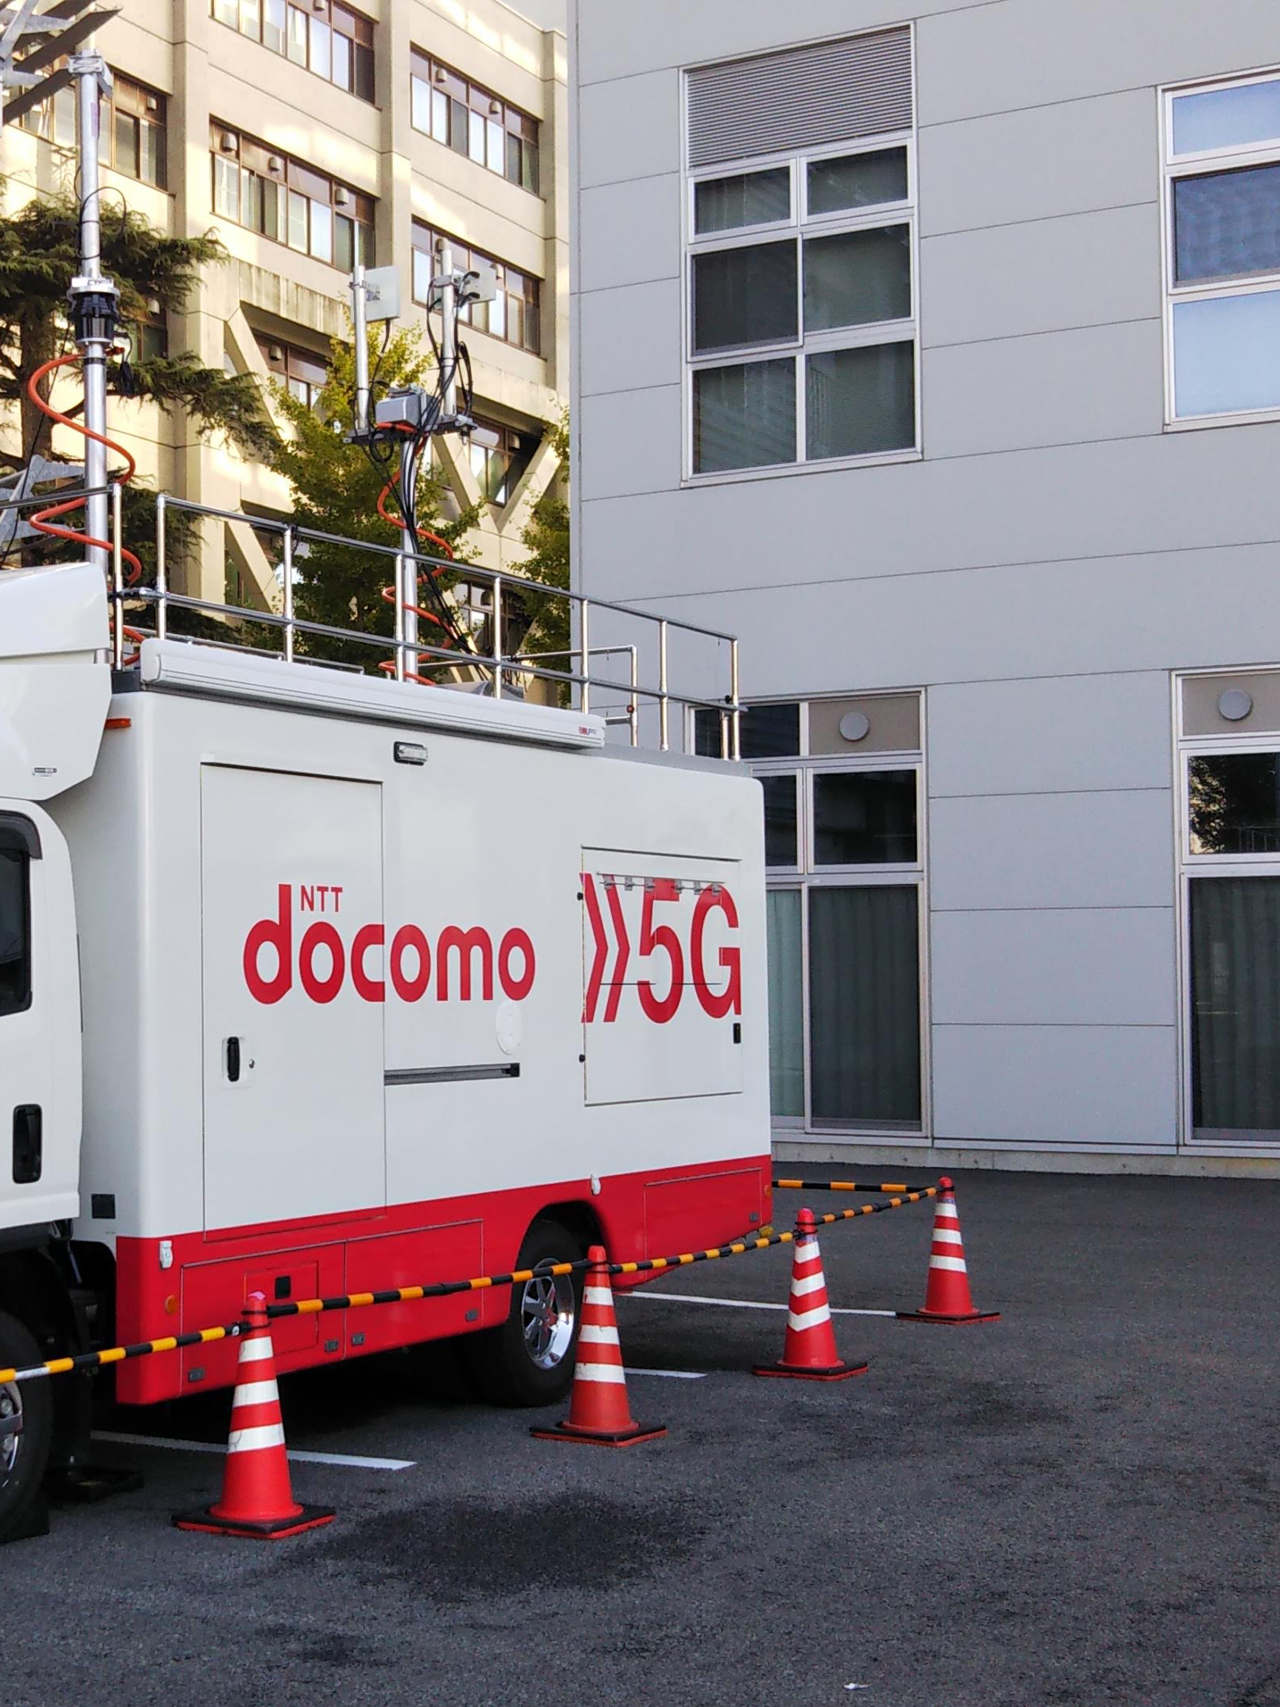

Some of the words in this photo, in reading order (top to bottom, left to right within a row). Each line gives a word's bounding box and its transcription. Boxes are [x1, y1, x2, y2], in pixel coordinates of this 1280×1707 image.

[300, 885, 343, 912] NTT
[243, 884, 536, 1004] docomo
[637, 877, 742, 1024] 5G
